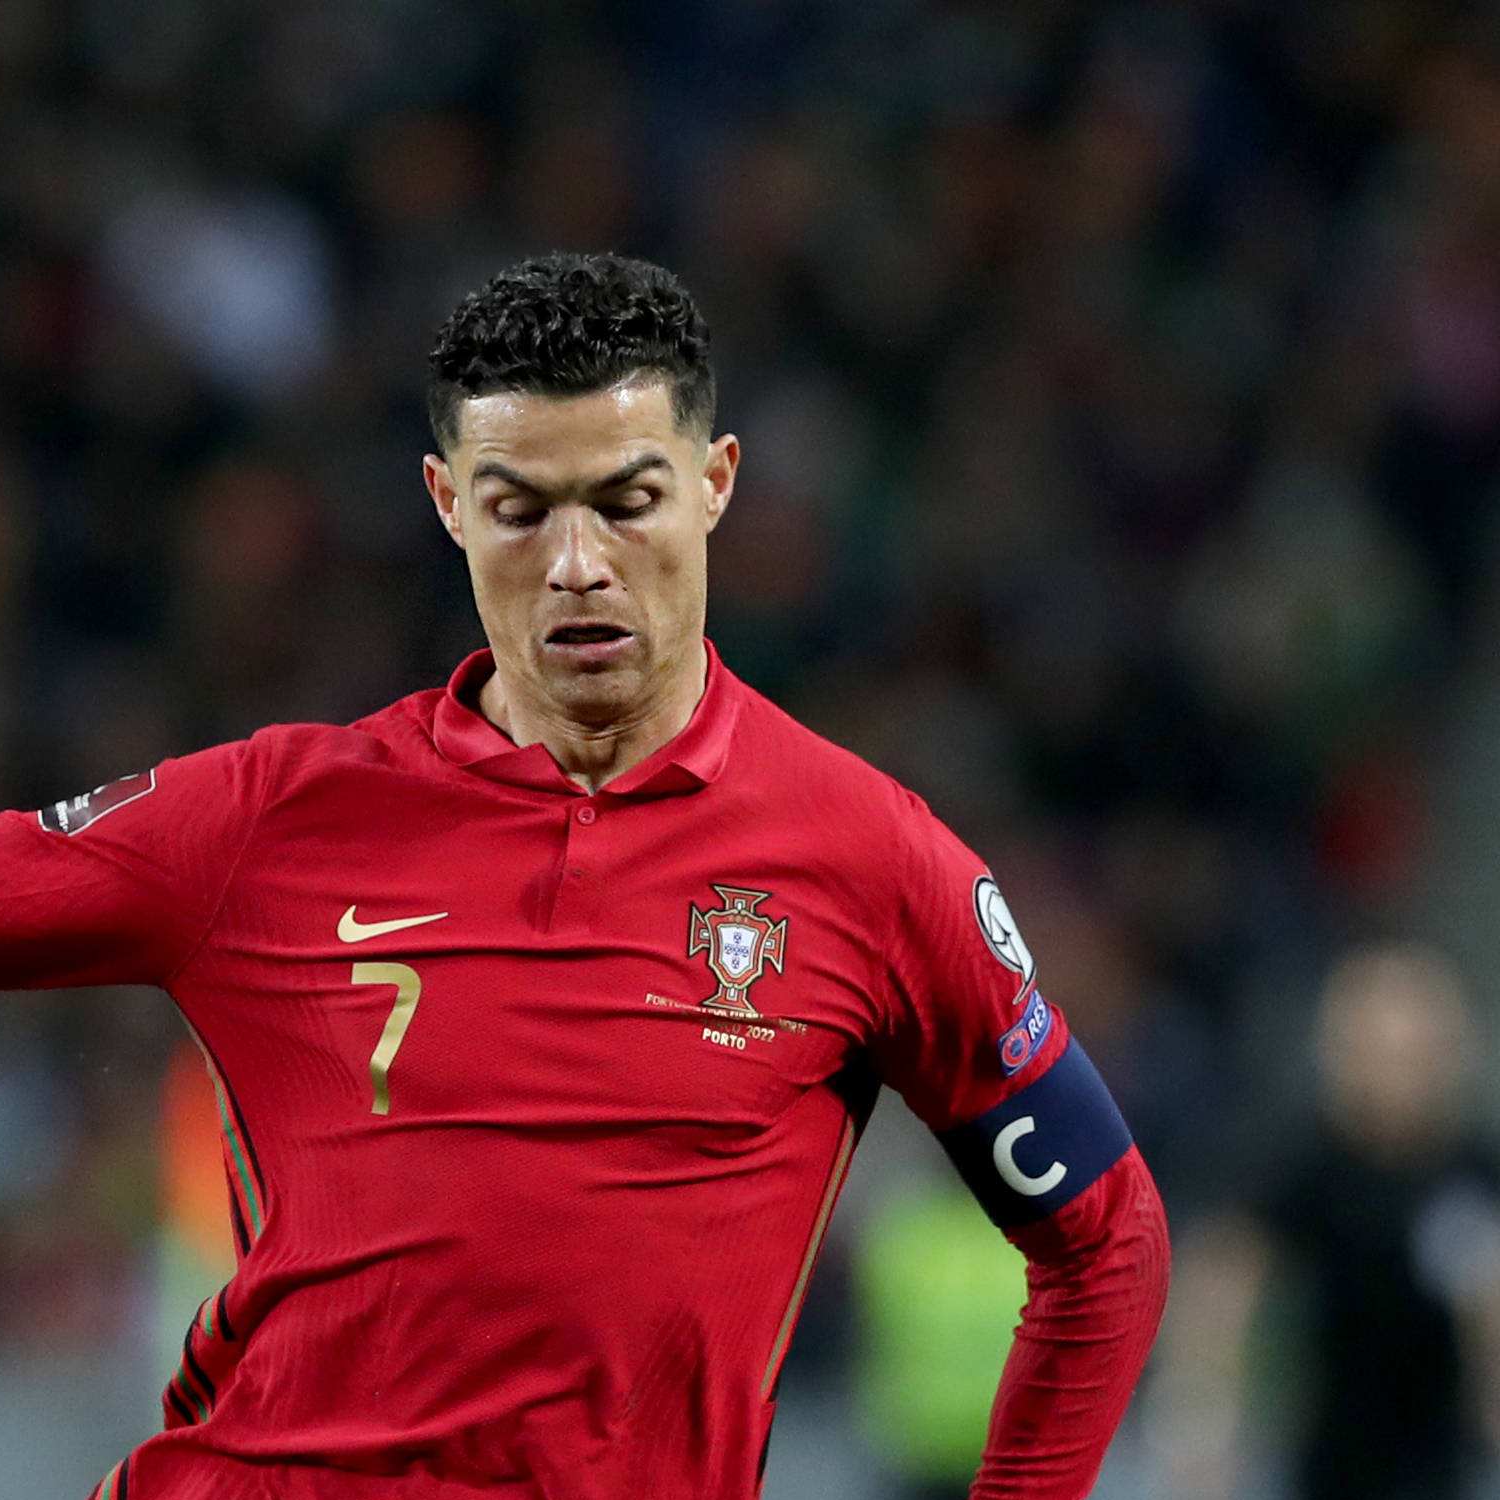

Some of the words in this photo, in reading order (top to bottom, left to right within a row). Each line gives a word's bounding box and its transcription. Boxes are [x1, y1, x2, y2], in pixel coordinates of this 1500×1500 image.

[350, 962, 422, 1116] 7
[702, 1028, 746, 1050] PORTO
[745, 1024, 775, 1043] 2022
[992, 1115, 1068, 1197] C
